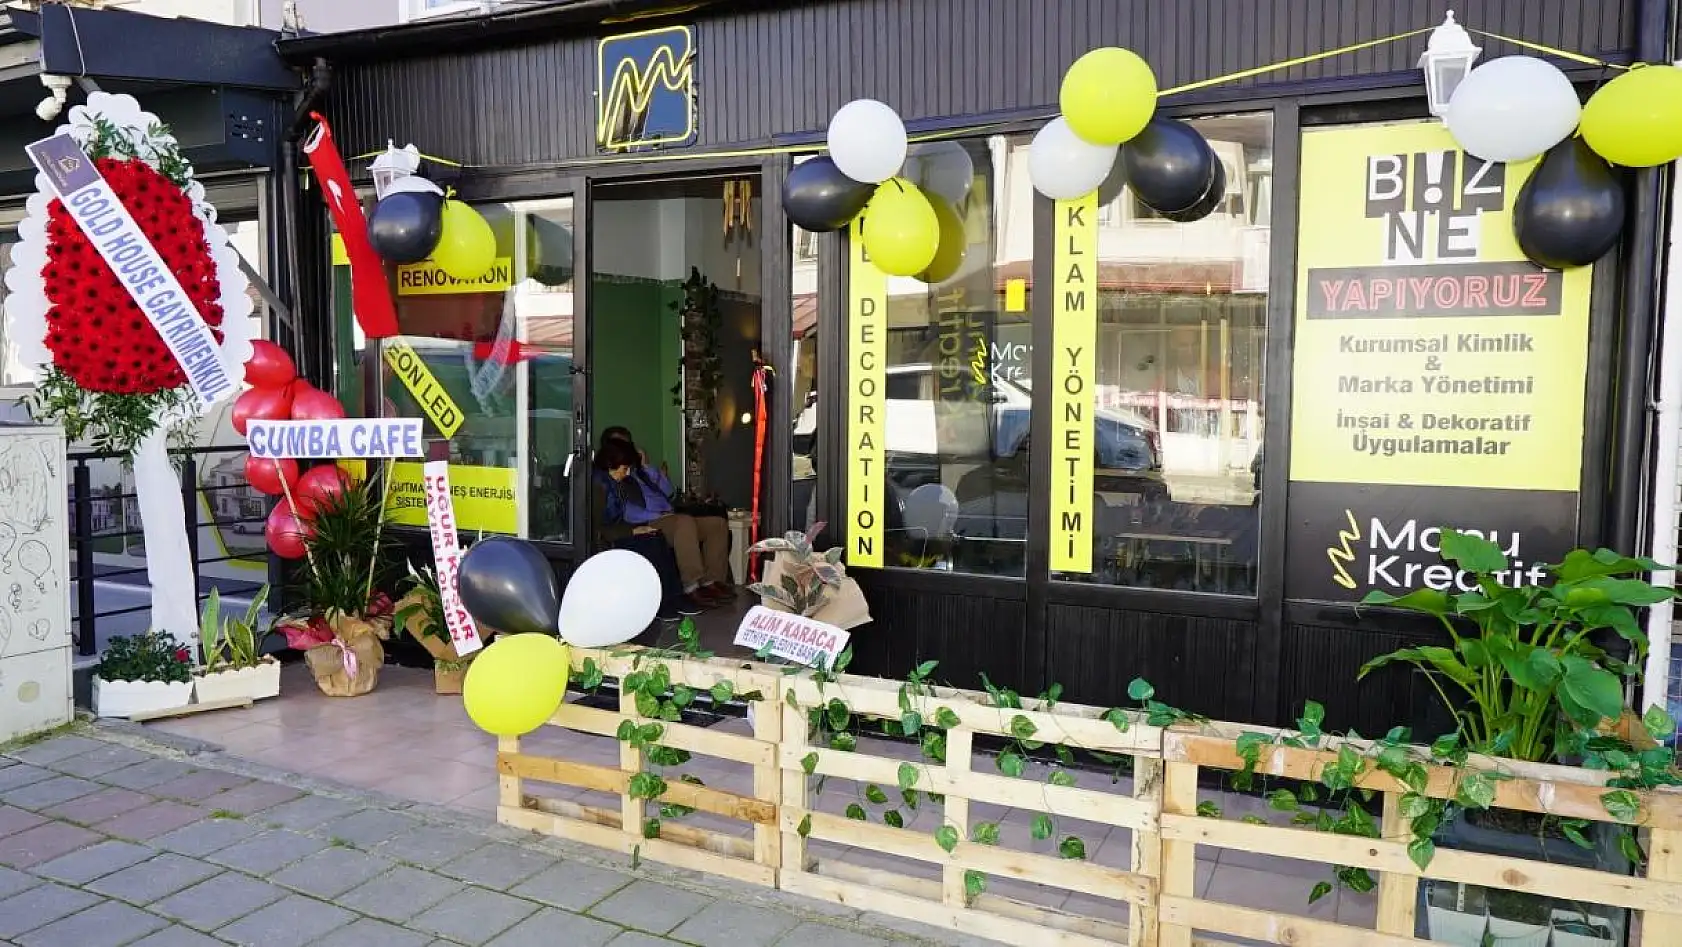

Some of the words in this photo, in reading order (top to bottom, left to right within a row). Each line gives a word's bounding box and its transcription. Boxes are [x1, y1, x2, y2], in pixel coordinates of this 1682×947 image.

[1387, 208, 1478, 260] NE
[70, 186, 124, 237] GOLD
[103, 231, 167, 296] HOUSE
[145, 288, 231, 404] GAYRİMENKUL
[1320, 273, 1549, 312] YAPIYORUZ
[1339, 333, 1449, 353] Kurumsal
[1456, 333, 1535, 353] Kimlik
[1424, 355, 1443, 371] &
[1338, 375, 1414, 395] Marka
[1420, 375, 1535, 395] Yönetimi
[421, 383, 456, 428] LED
[1396, 413, 1415, 429] &
[1421, 412, 1532, 432] Dekoratif
[249, 424, 343, 457] CUMBA
[350, 423, 418, 457] CAFE
[857, 297, 876, 557] DECORATION
[1061, 347, 1084, 559] YÖNETİMİ
[1352, 433, 1512, 457] Uygulamalar
[781, 620, 838, 652] KARACA
